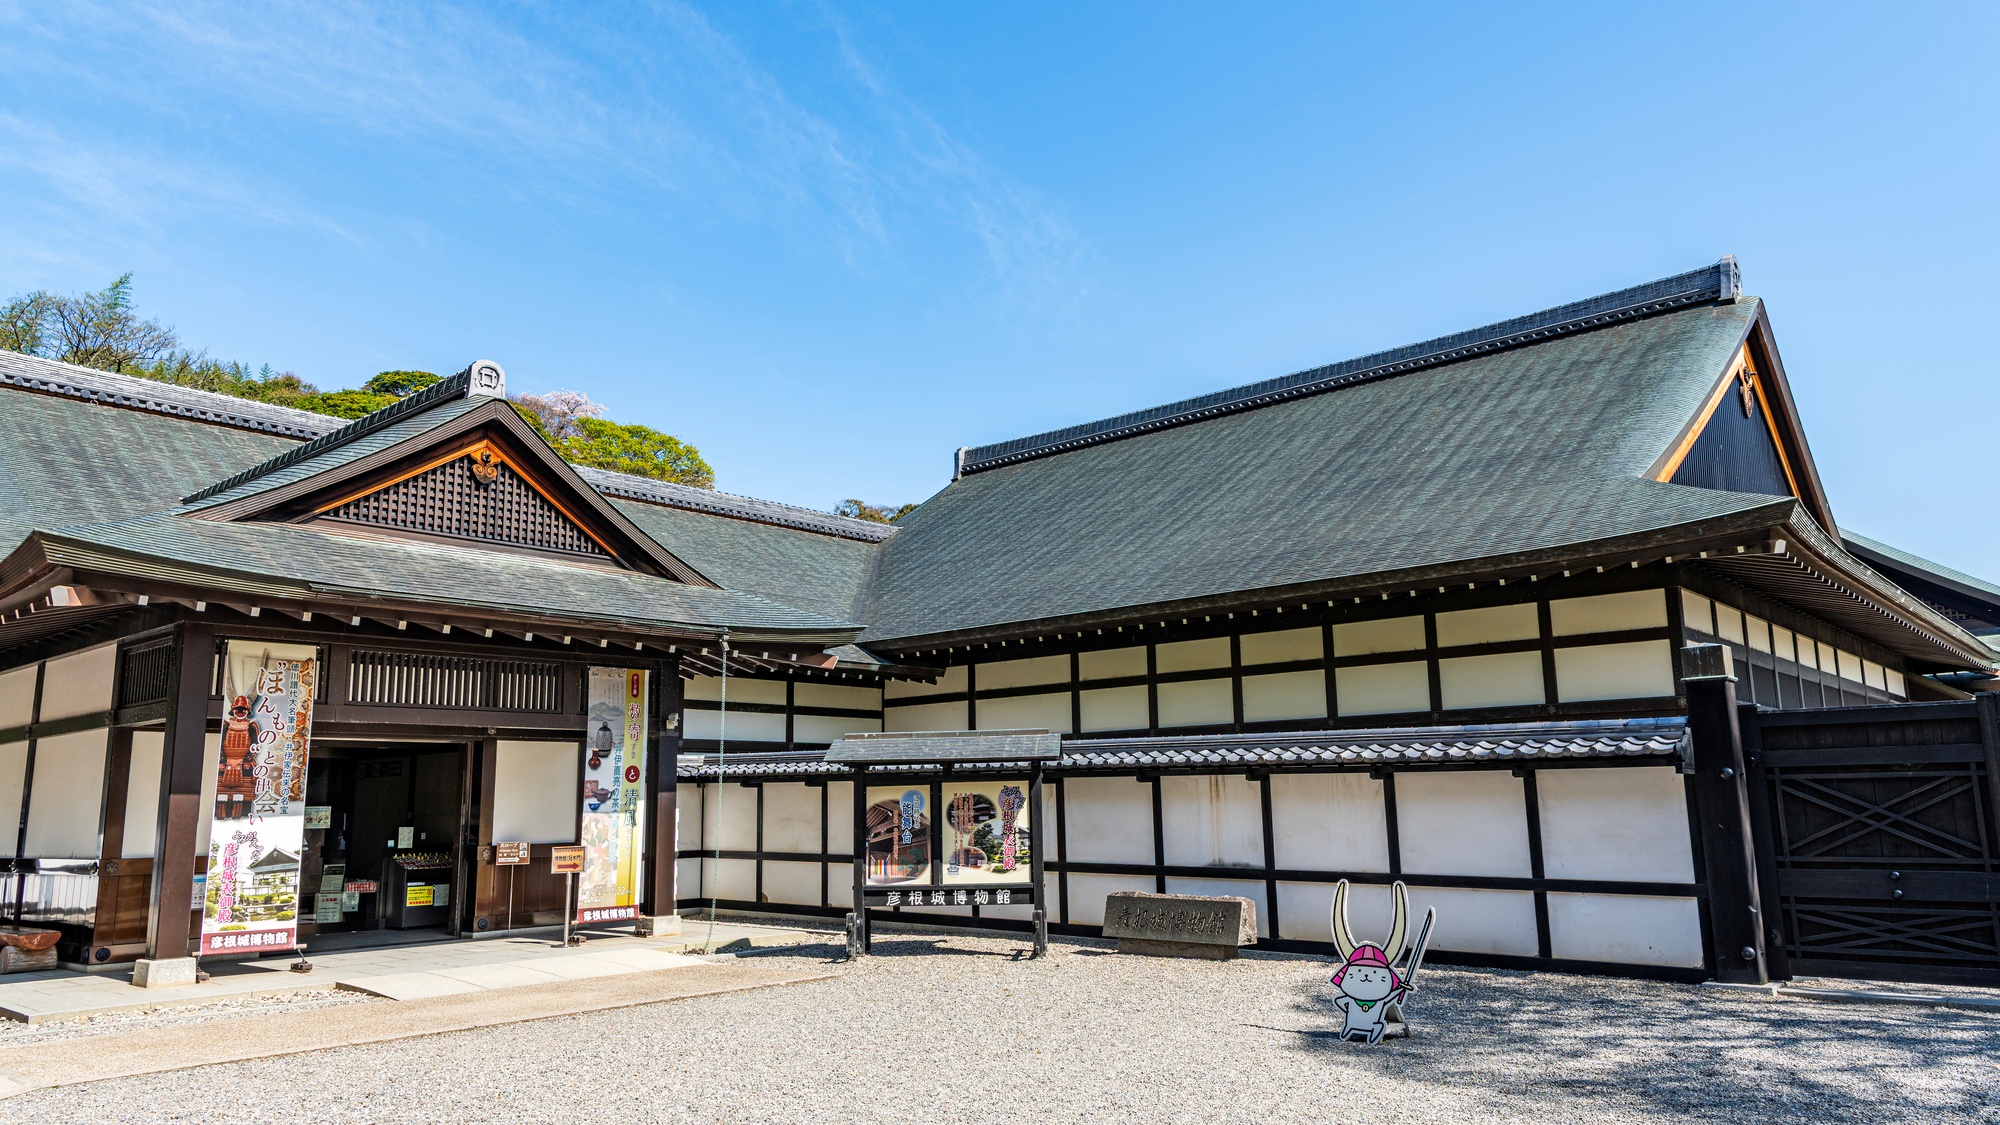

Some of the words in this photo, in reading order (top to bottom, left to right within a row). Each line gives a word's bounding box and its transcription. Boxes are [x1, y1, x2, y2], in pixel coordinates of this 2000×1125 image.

[280, 662, 300, 814] 徳川譜代大名筆頭・井伊家伝来の名宝
[902, 802, 913, 844] 能舞台
[1001, 798, 1016, 870] 彦根城表御殿
[232, 830, 264, 860] よみがえった
[217, 843, 237, 922] 彦根城表御殿
[886, 889, 1011, 906] 彦根城博物館
[583, 908, 635, 921] 彦根城博物館
[1115, 904, 1227, 936] 彦根城博物館
[210, 932, 288, 948] 彦根城博物館
